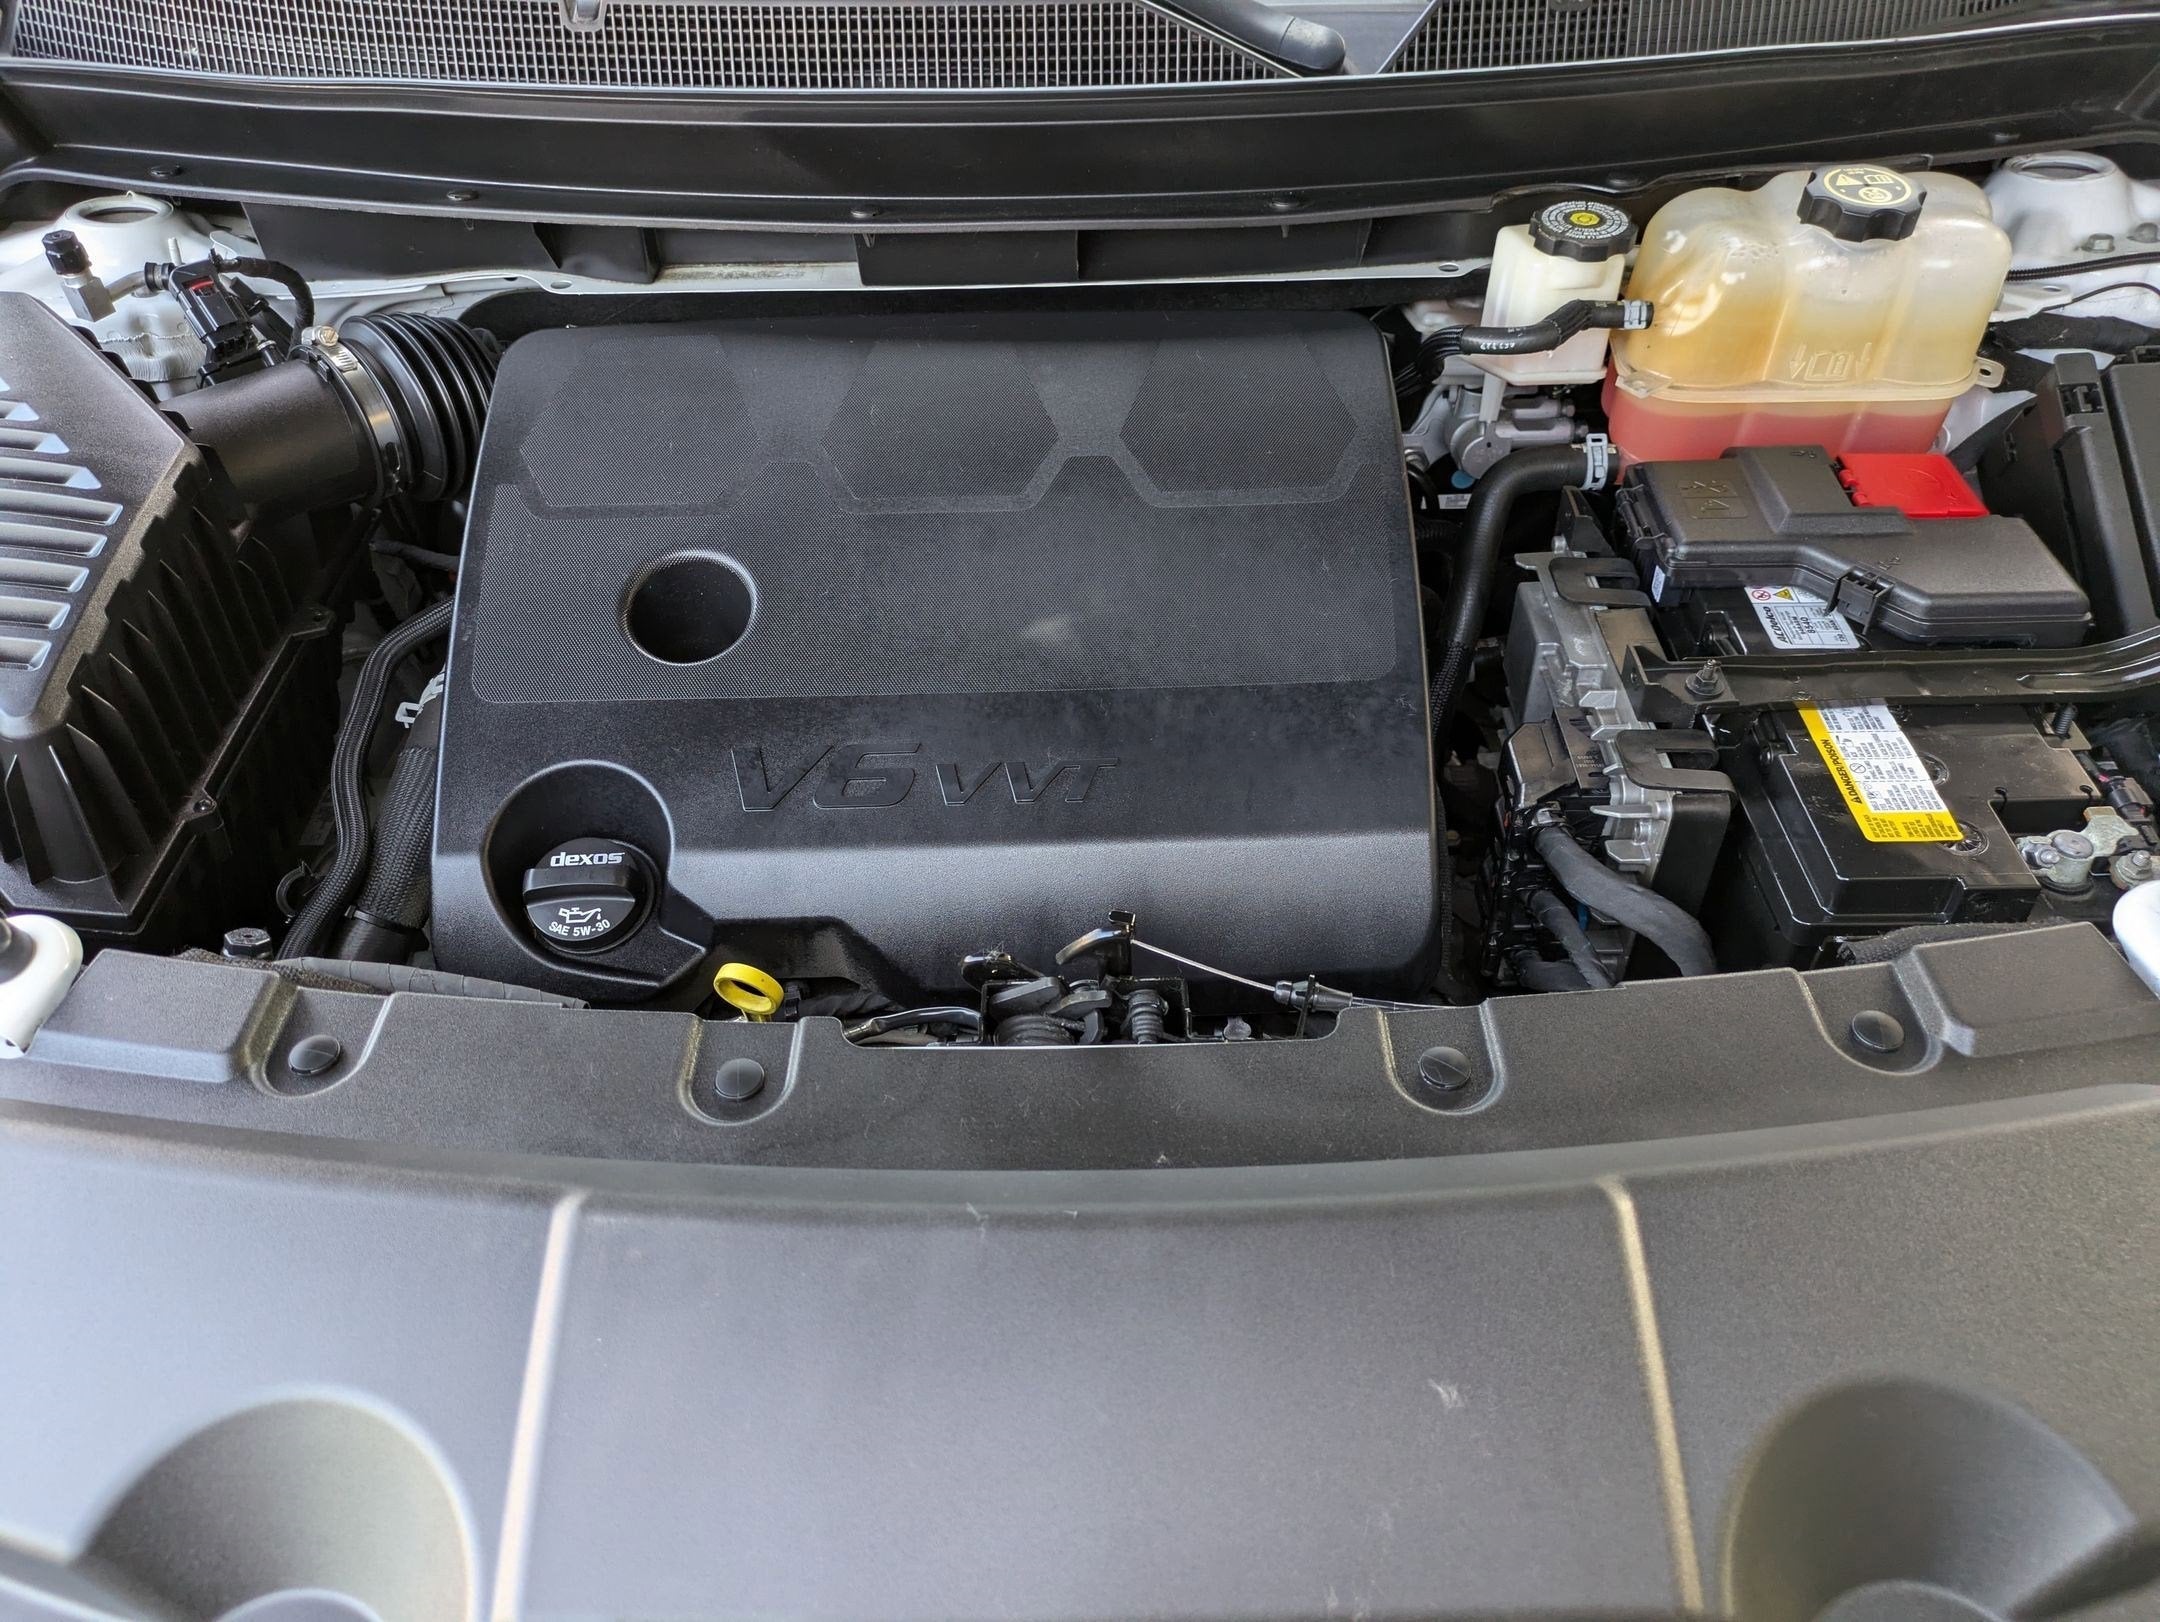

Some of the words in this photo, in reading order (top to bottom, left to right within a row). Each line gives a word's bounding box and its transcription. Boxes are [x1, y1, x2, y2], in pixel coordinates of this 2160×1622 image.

[1763, 606, 1789, 644] ACDelco
[731, 742, 921, 811] V6
[935, 757, 1119, 806] VVT
[550, 852, 625, 867] dexos
[548, 921, 570, 936] SAE
[572, 919, 610, 936] 5W-30
